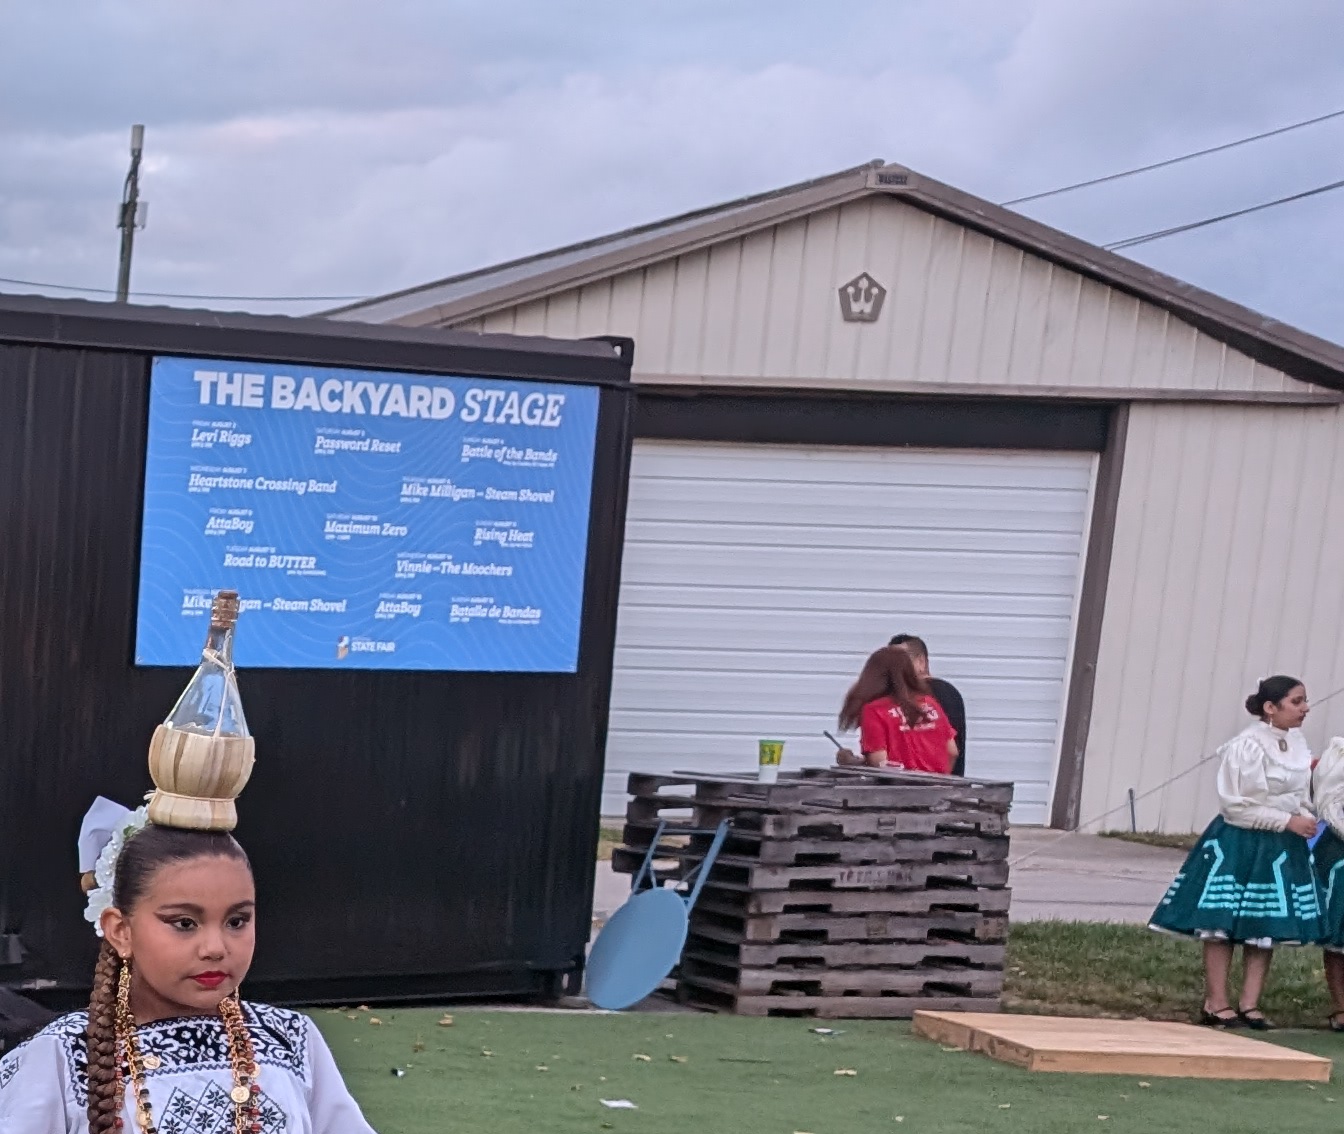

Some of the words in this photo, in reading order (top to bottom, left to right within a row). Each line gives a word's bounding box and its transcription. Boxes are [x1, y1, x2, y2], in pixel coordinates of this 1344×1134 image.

[194, 370, 264, 408] THE
[271, 375, 455, 420] BACKYARD
[460, 387, 565, 427] STAGE
[192, 428, 218, 442] Levi
[219, 430, 252, 448] Riggs
[315, 436, 370, 450] Password
[371, 439, 401, 453] Reset
[462, 445, 493, 458] Battle
[494, 447, 507, 462] of
[507, 447, 523, 460] the
[524, 449, 557, 462] Bands
[189, 474, 254, 489] Heartstone
[255, 477, 307, 495] Crossing
[307, 480, 337, 493] Band
[401, 483, 429, 496] Mike
[429, 485, 476, 501] Milligan
[485, 487, 517, 500] Steam
[519, 489, 555, 503] Shovel
[206, 517, 254, 534] AttaBoy
[324, 521, 380, 535] Maximum
[381, 523, 408, 537] Zero
[474, 528, 507, 544] Rising
[508, 529, 534, 542] Heat
[223, 554, 254, 567] Road
[255, 556, 267, 567] to
[268, 556, 316, 569] BUTTER
[397, 560, 432, 574] Vinnie
[440, 561, 461, 574] The
[461, 562, 512, 576] Moochers
[182, 595, 212, 608] Mike
[272, 598, 308, 612] Steam
[309, 599, 347, 612] Shovel
[376, 601, 421, 617] AttaBoy
[488, 606, 501, 617] de
[502, 606, 541, 618] Bandas
[351, 641, 375, 652] STATE
[376, 642, 395, 652] FAIR
